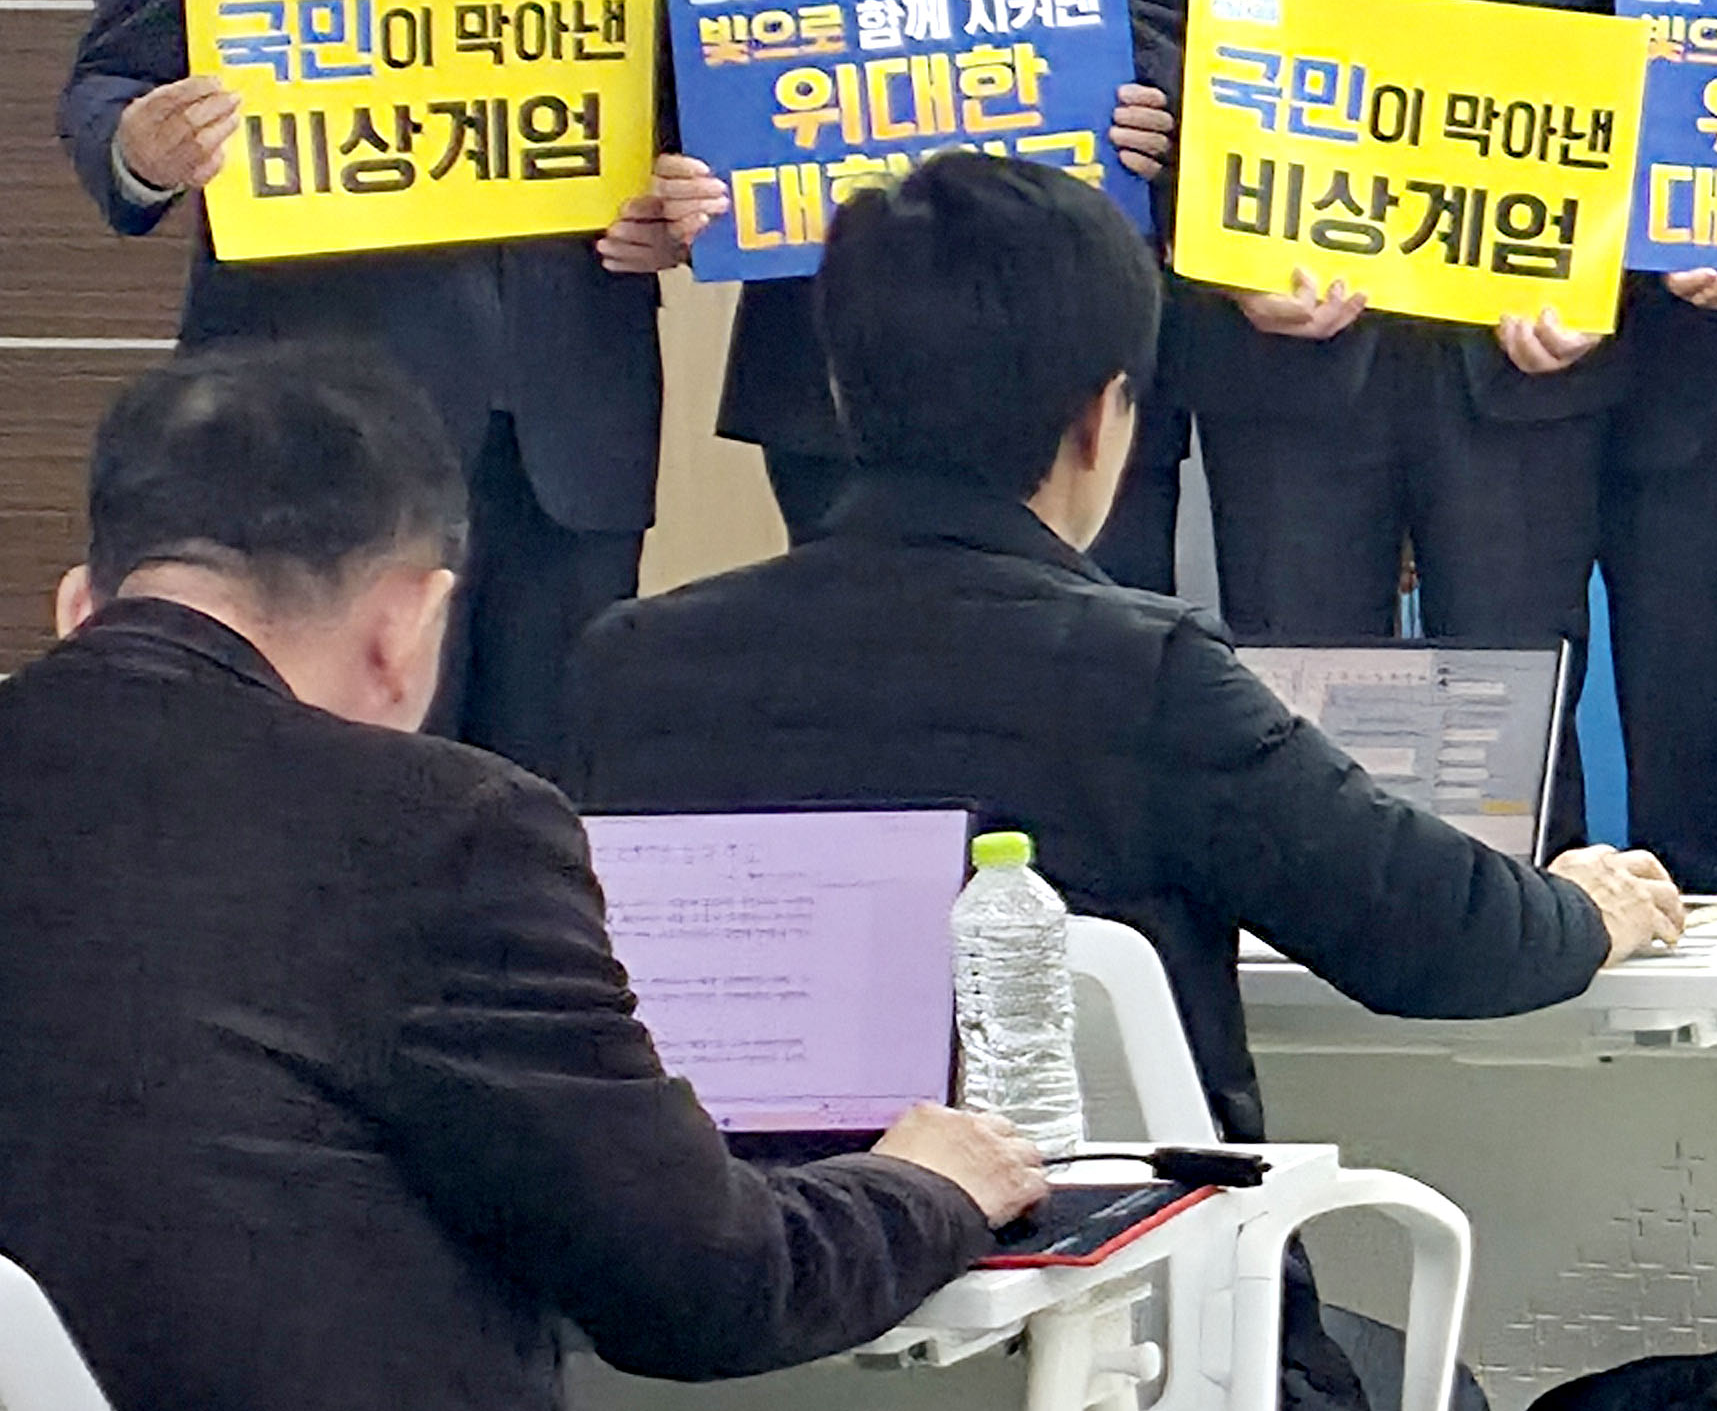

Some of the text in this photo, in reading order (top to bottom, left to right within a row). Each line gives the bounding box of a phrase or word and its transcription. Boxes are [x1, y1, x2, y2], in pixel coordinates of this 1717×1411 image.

[454, 0, 626, 65] 막아낸
[699, 3, 848, 66] 빛으로
[245, 92, 601, 199] 비상계엄
[771, 42, 1050, 149] 위대한
[1211, 46, 1615, 170] 국민이 막아낸
[1222, 153, 1579, 280] 비상계엄
